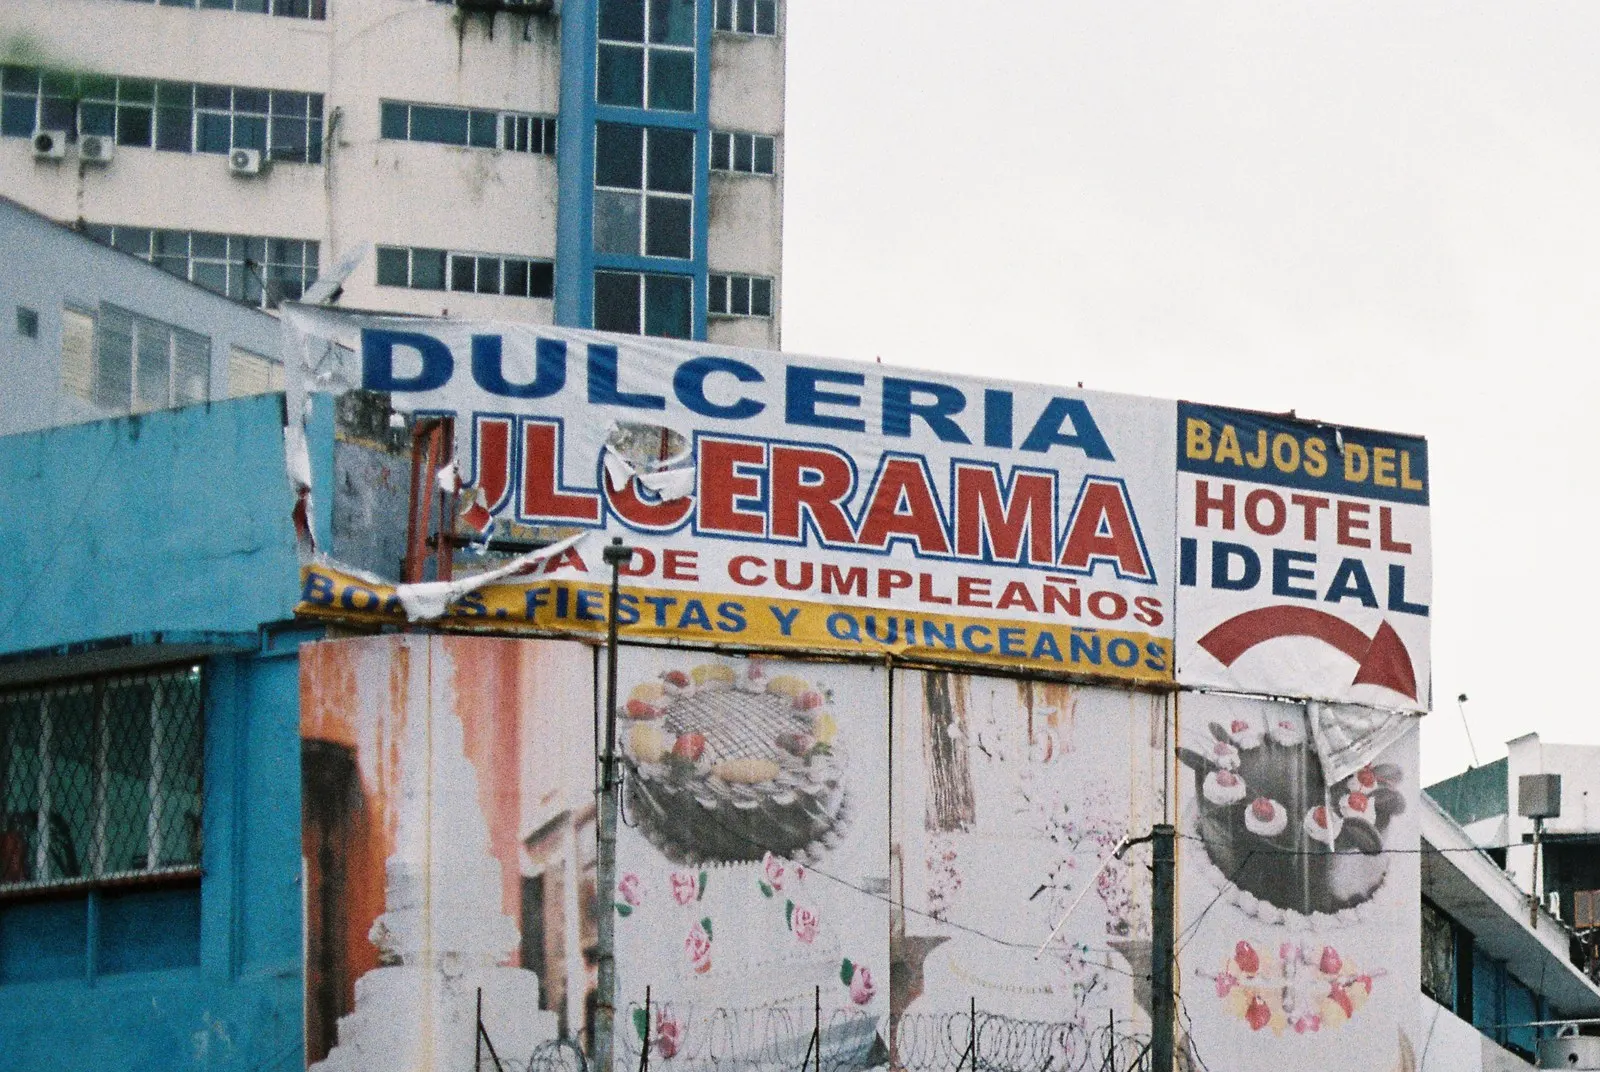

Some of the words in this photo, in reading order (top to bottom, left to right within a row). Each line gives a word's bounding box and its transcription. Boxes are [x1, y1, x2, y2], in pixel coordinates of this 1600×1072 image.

[360, 327, 1116, 462] DULCERIA
[1186, 418, 1328, 478] BAJOS
[1343, 442, 1423, 491] DEL
[1195, 479, 1413, 555] HOTEL
[617, 546, 699, 583] DE
[727, 553, 1166, 628] CUMPLEAÑOS
[1179, 536, 1430, 618] IDEAL
[525, 586, 748, 634] FIESTAS
[769, 606, 801, 637] Y
[826, 611, 1168, 672] QUINCEAÑOS
